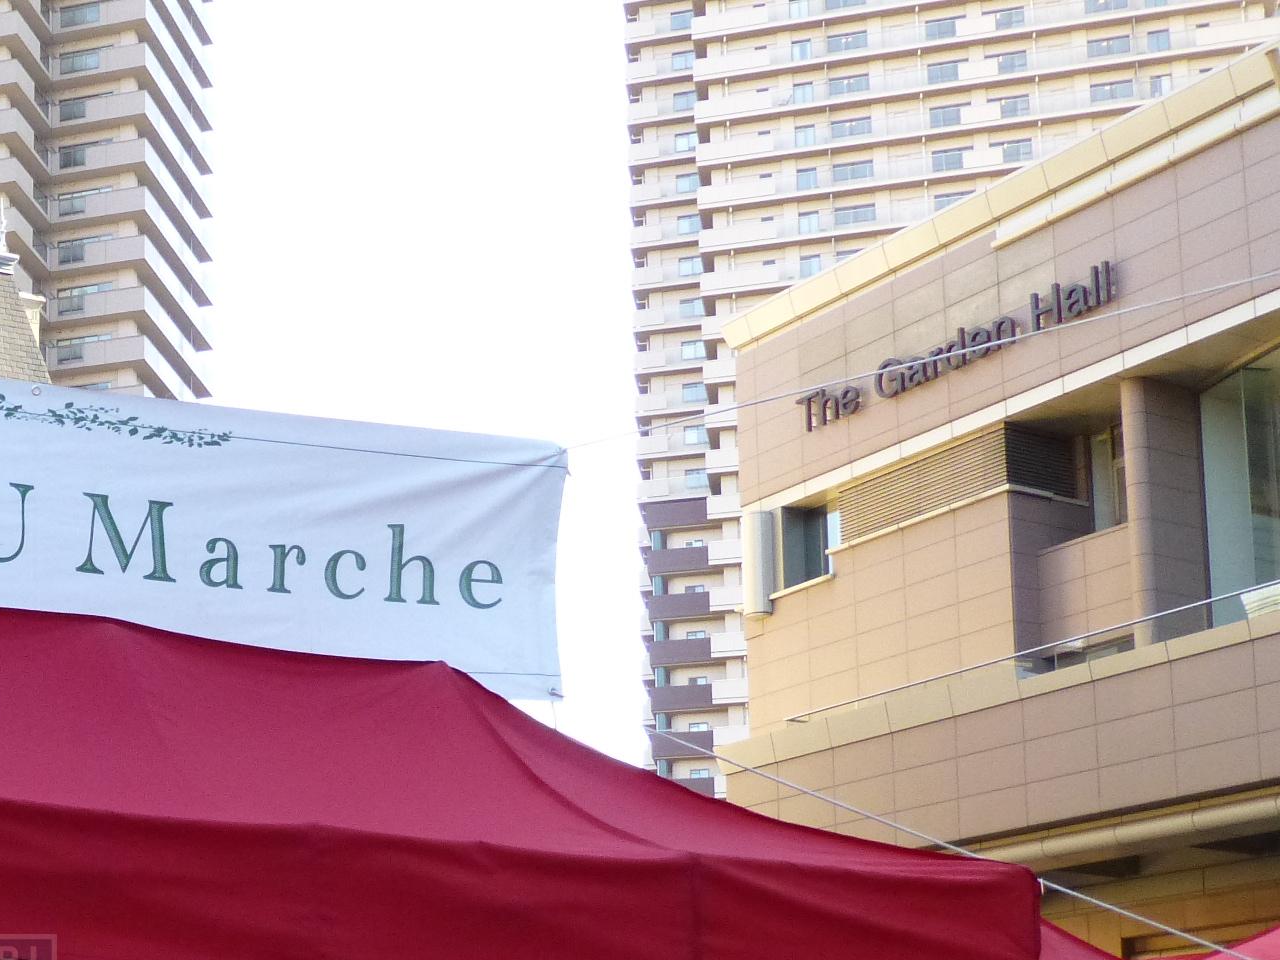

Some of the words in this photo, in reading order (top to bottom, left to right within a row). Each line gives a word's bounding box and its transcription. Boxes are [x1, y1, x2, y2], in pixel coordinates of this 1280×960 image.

[795, 388, 861, 432] The
[874, 316, 1017, 398] Garden
[1031, 260, 1112, 332] Hall
[75, 492, 503, 609] Marche
